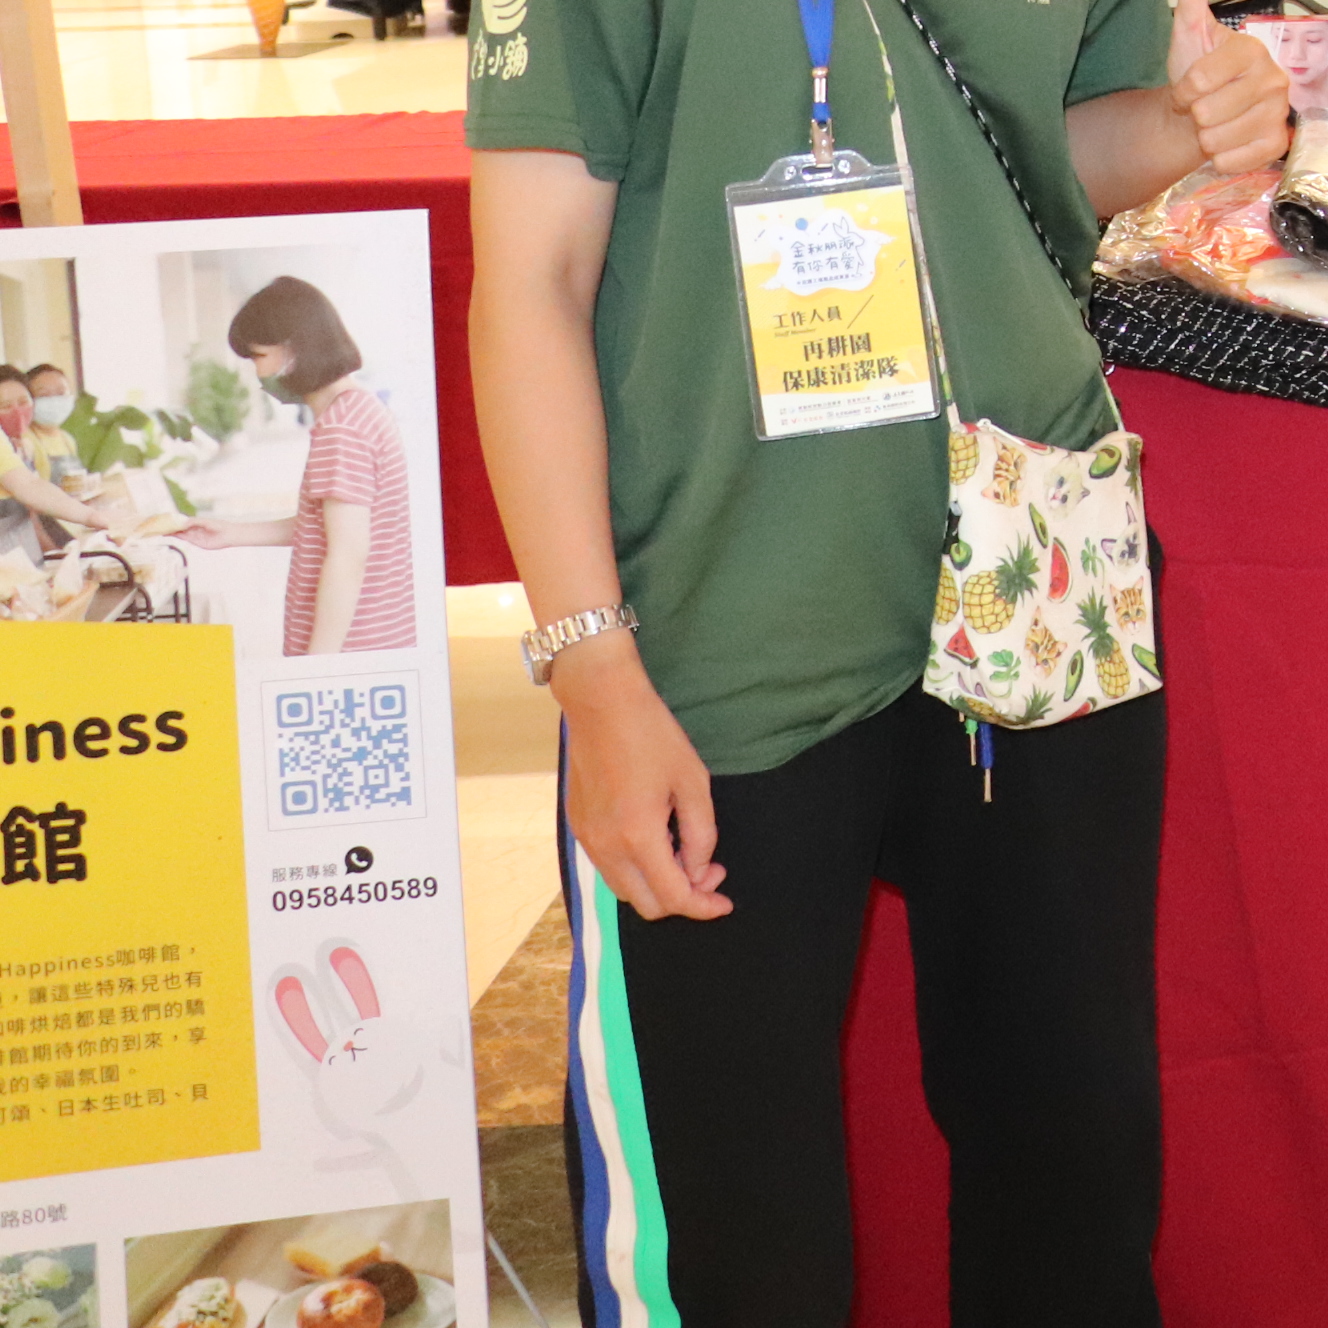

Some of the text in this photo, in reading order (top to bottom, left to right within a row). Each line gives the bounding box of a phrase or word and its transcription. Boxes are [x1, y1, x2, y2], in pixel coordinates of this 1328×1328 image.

[773, 305, 842, 330] 工作人員
[803, 332, 872, 362] 再耕園
[782, 355, 900, 393] 保康清潔隊
[0, 802, 88, 886] 館
[271, 862, 339, 883] 服務專線
[271, 877, 439, 913] 0958450589
